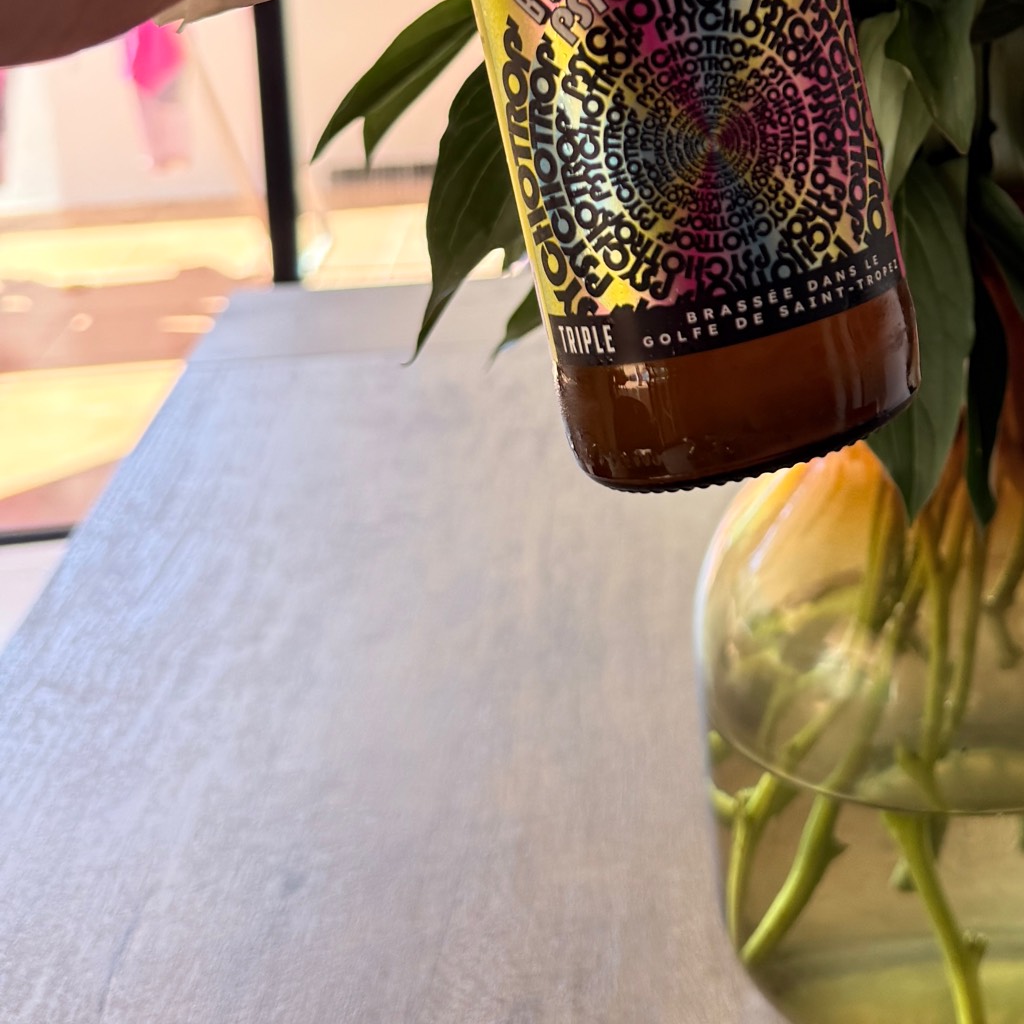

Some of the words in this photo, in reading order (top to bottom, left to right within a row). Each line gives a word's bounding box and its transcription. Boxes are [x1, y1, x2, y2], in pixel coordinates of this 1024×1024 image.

[642, 325, 719, 349] GOLFE
[735, 313, 765, 330] DE
[779, 259, 899, 319] SAINT-TROPEZ
[687, 288, 794, 325] BRASSÉE
[807, 265, 858, 293] DANS
[866, 254, 880, 274] LE
[558, 325, 616, 355] TRIPLE
